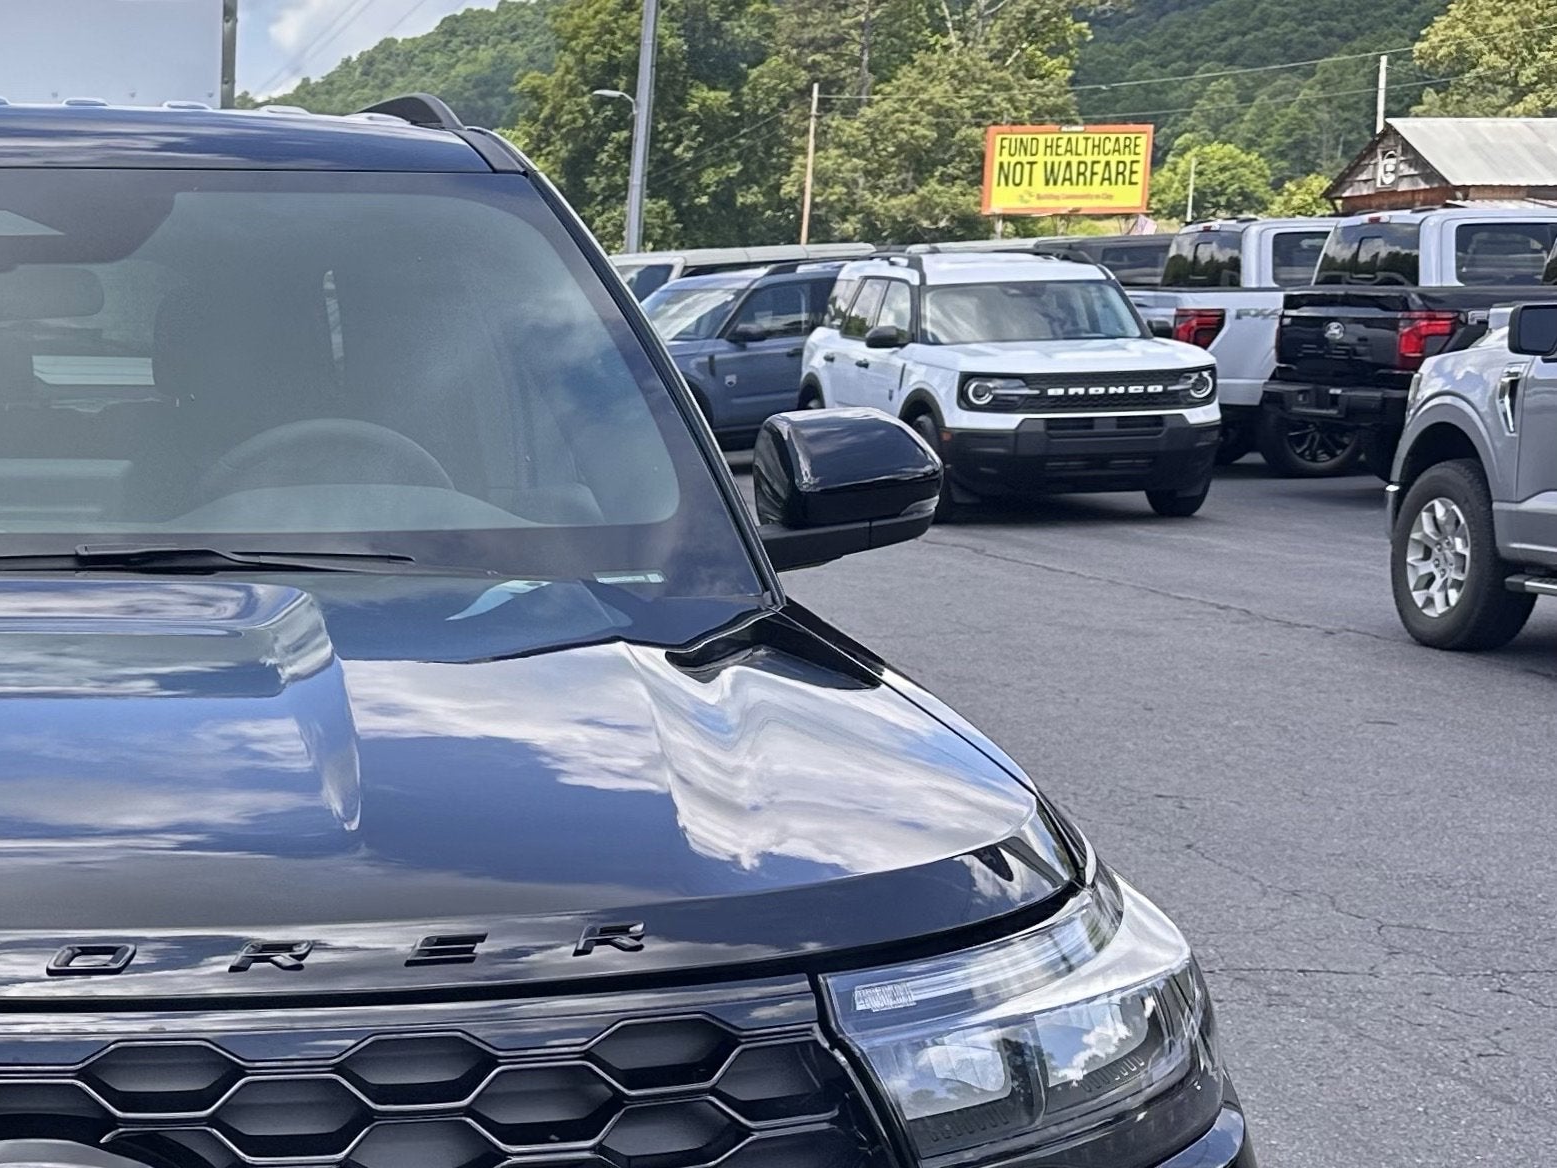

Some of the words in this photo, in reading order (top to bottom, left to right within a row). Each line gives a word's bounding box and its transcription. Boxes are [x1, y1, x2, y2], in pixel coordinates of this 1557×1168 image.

[999, 137, 1039, 158] FUND
[1044, 136, 1142, 157] HEALTHCARE
[997, 161, 1038, 187] NOT
[1043, 159, 1140, 187] WARFARE
[1047, 385, 1163, 396] BRONCO
